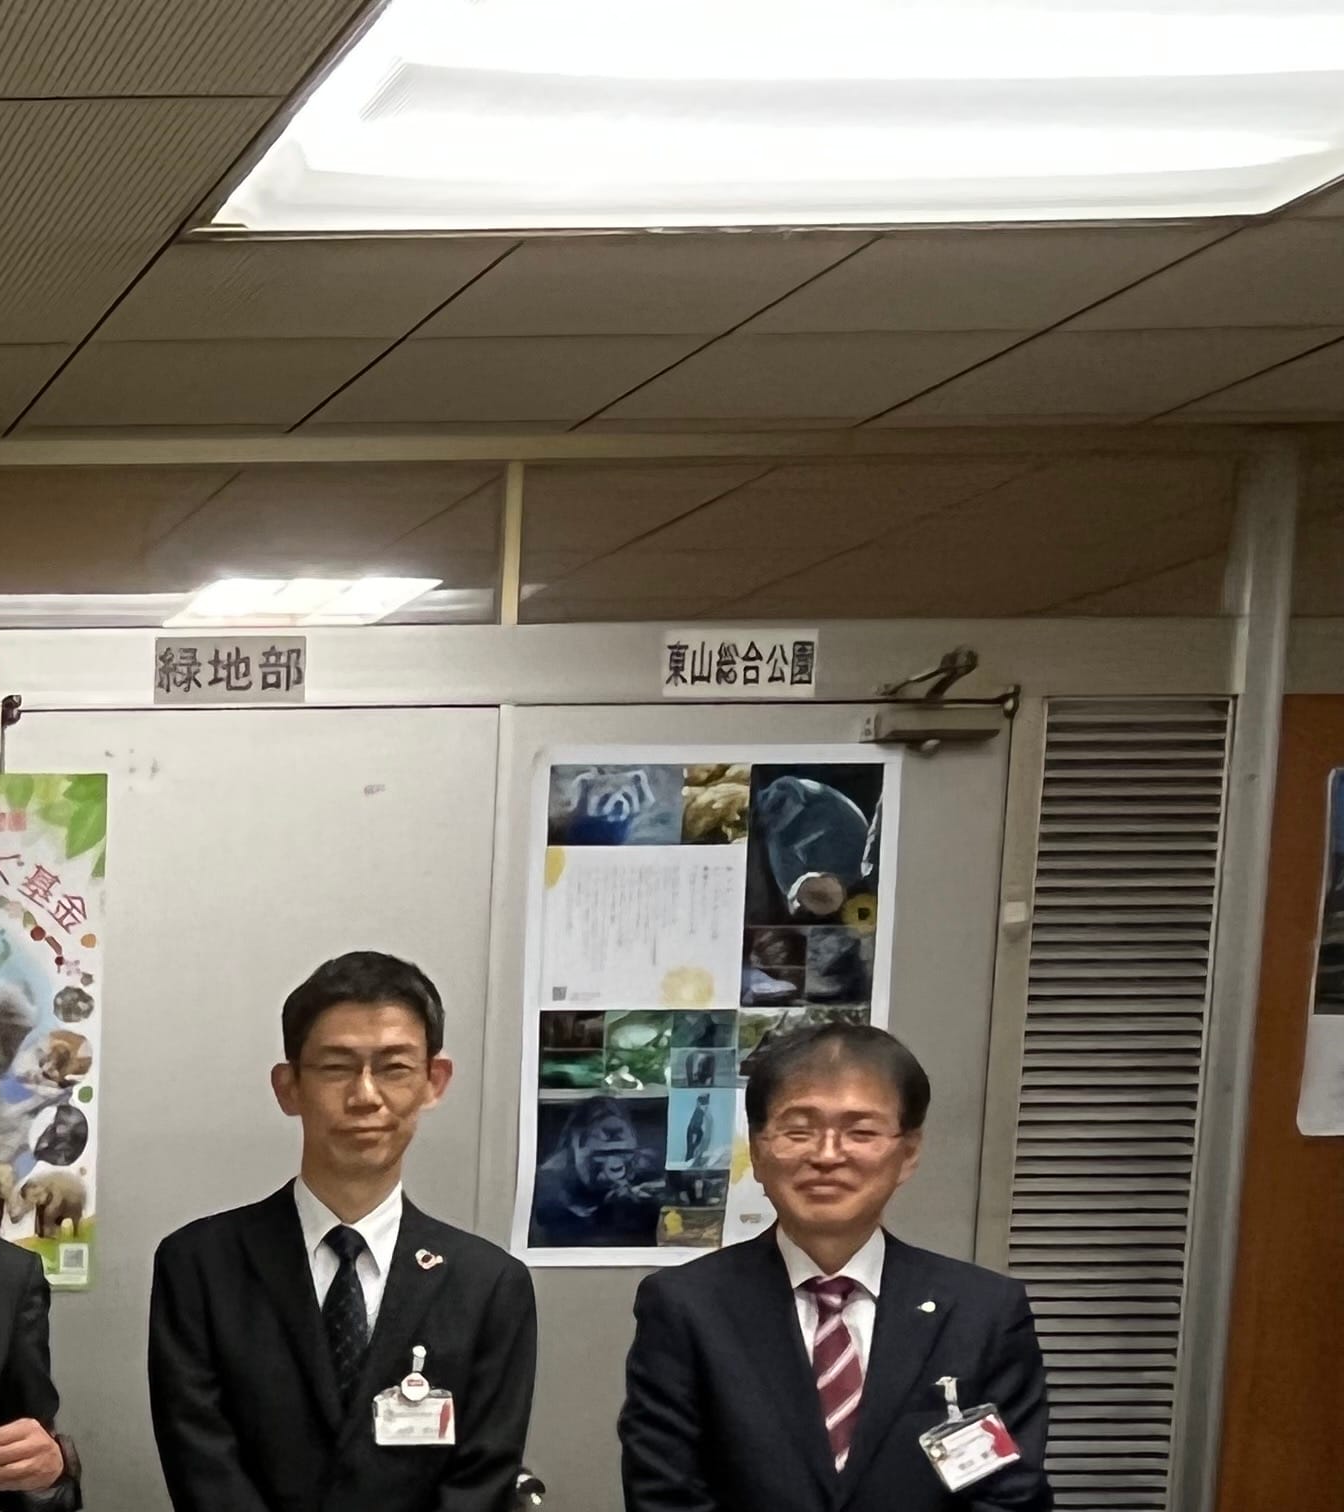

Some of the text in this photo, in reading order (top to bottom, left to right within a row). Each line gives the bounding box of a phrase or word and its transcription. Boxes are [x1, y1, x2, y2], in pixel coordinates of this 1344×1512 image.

[158, 646, 302, 693] 緑地部
[666, 640, 815, 687] 東山総合公園
